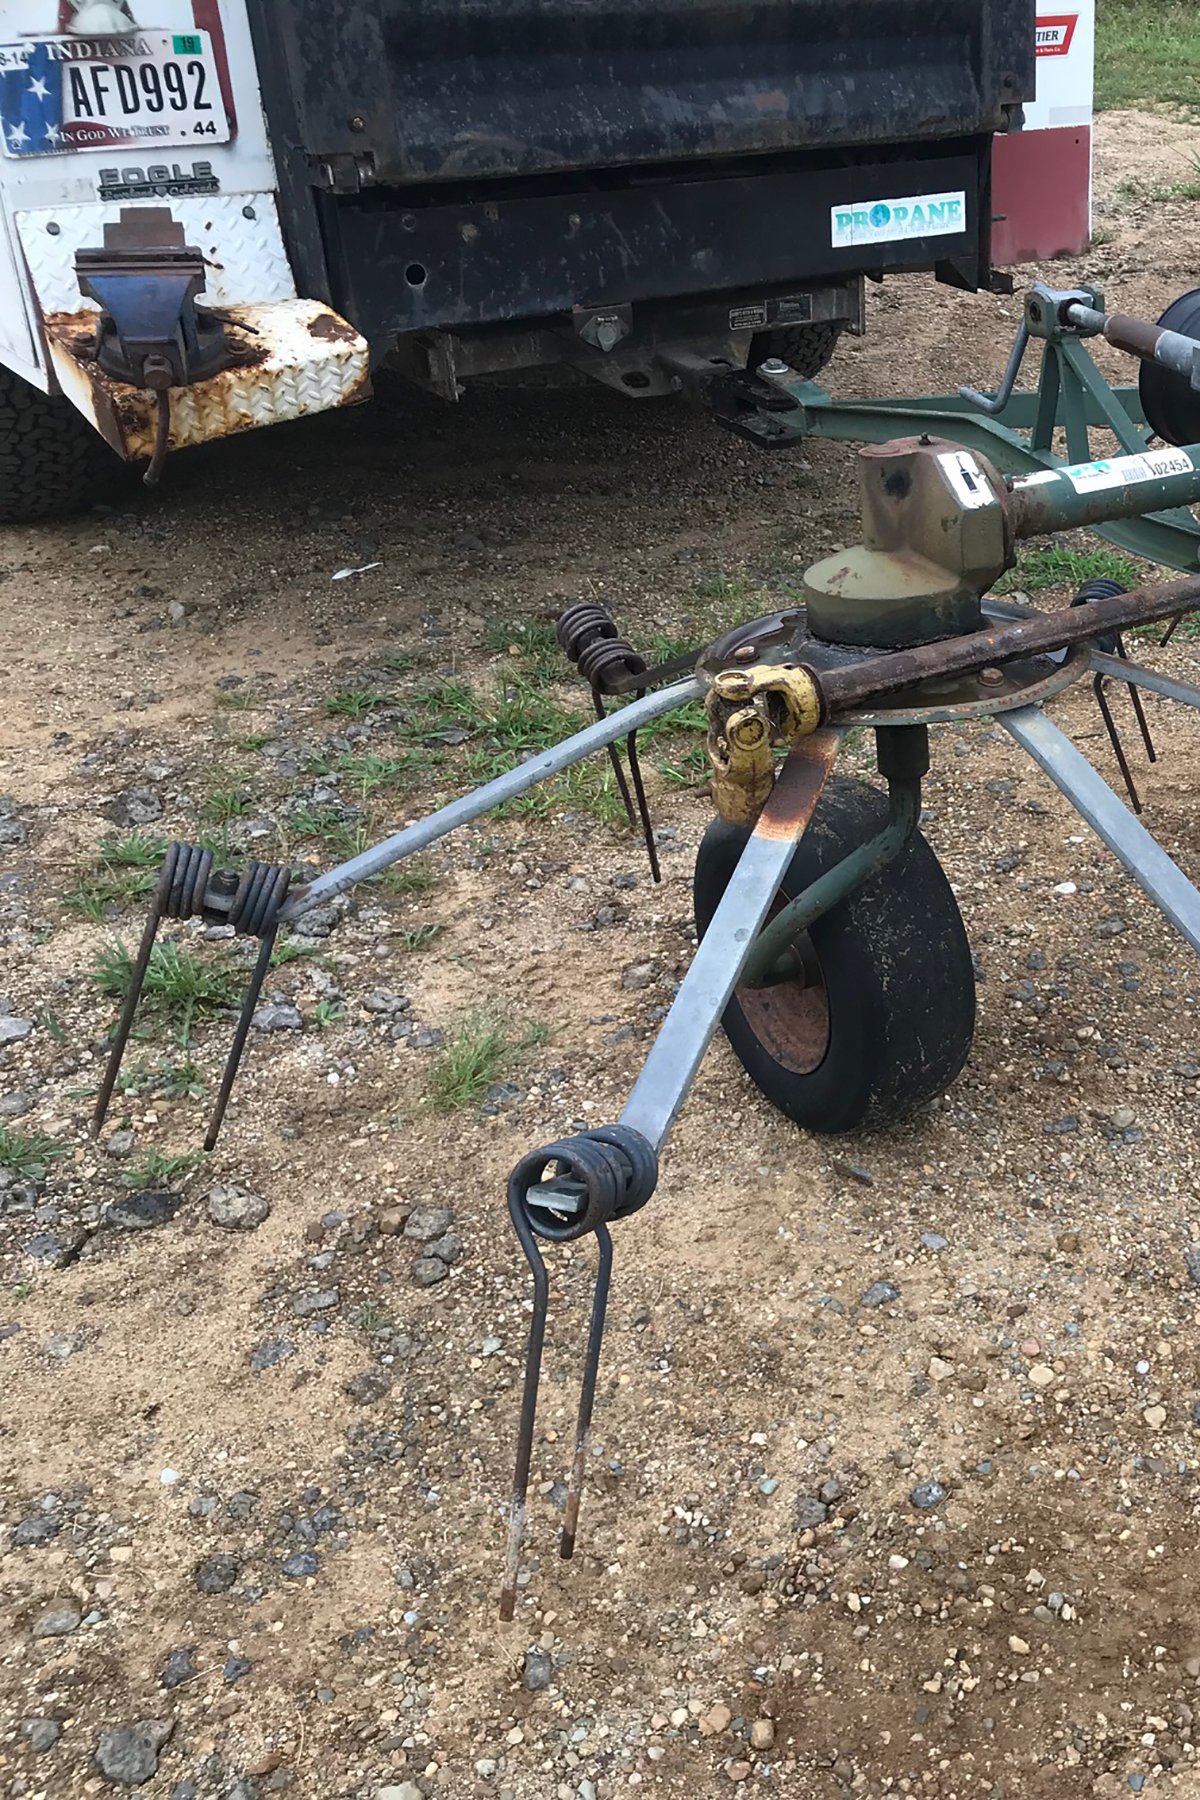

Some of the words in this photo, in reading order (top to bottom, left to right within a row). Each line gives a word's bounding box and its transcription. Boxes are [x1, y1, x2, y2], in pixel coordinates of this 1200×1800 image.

[180, 36, 195, 49] 19
[1036, 30, 1059, 42] TIER
[45, 38, 153, 60] INDIANA
[69, 60, 213, 117] AFD992
[193, 120, 217, 135] 44
[835, 200, 961, 233] PROPANE
[1153, 458, 1190, 475] 02454
